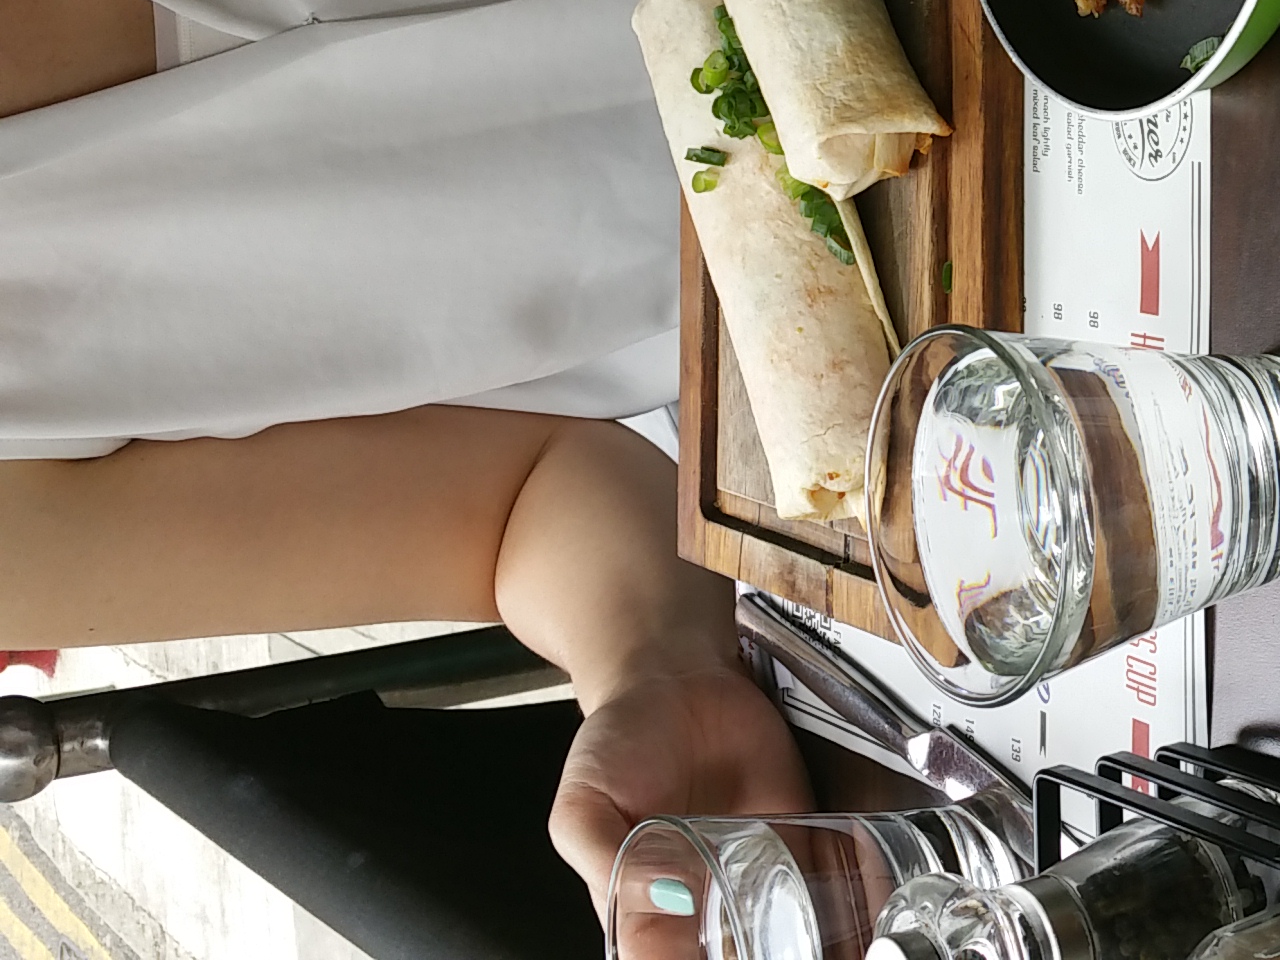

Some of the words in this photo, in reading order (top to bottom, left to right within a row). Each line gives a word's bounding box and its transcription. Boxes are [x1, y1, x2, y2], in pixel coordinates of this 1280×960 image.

[1042, 127, 1050, 156] lightly
[1053, 303, 1062, 320] 98
[1088, 311, 1098, 328] 98
[1126, 654, 1157, 707] CUP
[1011, 738, 1022, 762] 139
